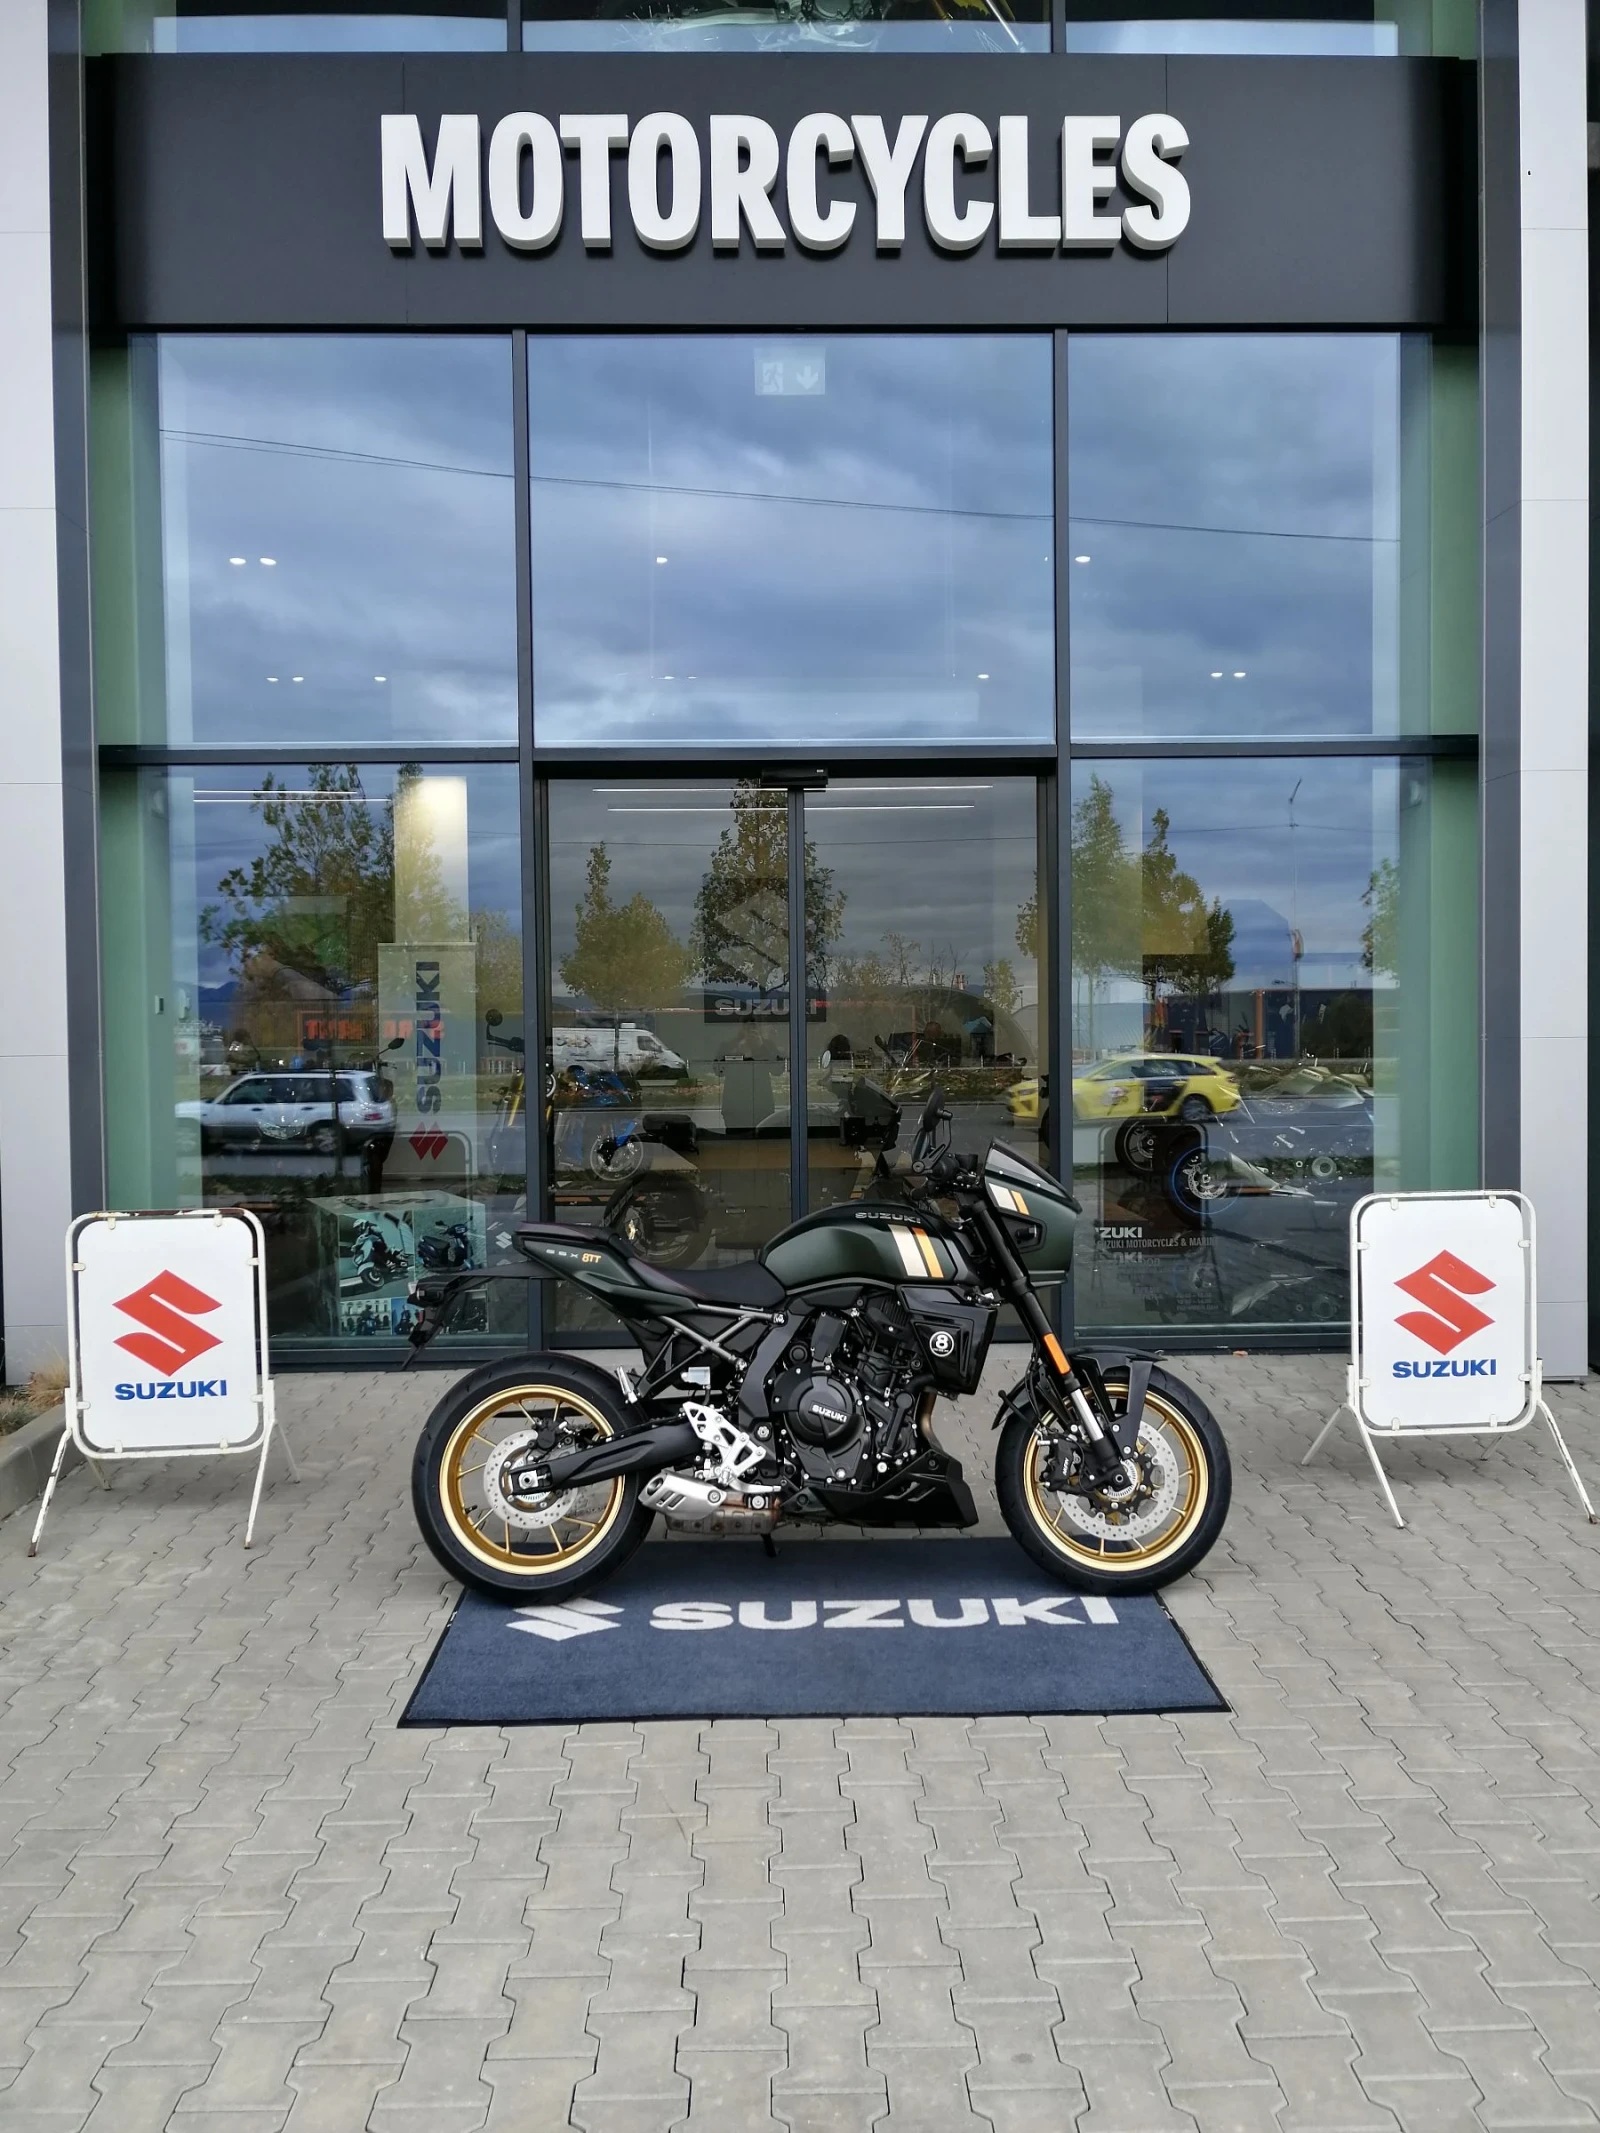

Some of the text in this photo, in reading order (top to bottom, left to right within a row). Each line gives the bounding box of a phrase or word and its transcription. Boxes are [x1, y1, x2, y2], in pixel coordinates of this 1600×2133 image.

[380, 111, 1193, 251] MOTORCYCLES
[714, 998, 817, 1016] SUZUI
[416, 961, 442, 1115] SUZUKI
[855, 1212, 921, 1224] SUZUKI
[1094, 1226, 1143, 1239] ZUKI
[1126, 1237, 1179, 1249] MOTORCYCLES
[1180, 1237, 1188, 1247] &
[582, 1253, 602, 1263] 8TT
[936, 1334, 949, 1350] 8
[1392, 1359, 1497, 1378] SUZUKI
[115, 1380, 227, 1400] SUZUKI
[812, 1404, 847, 1422] SUZUKI
[649, 1596, 1119, 1631] SUZUKI
